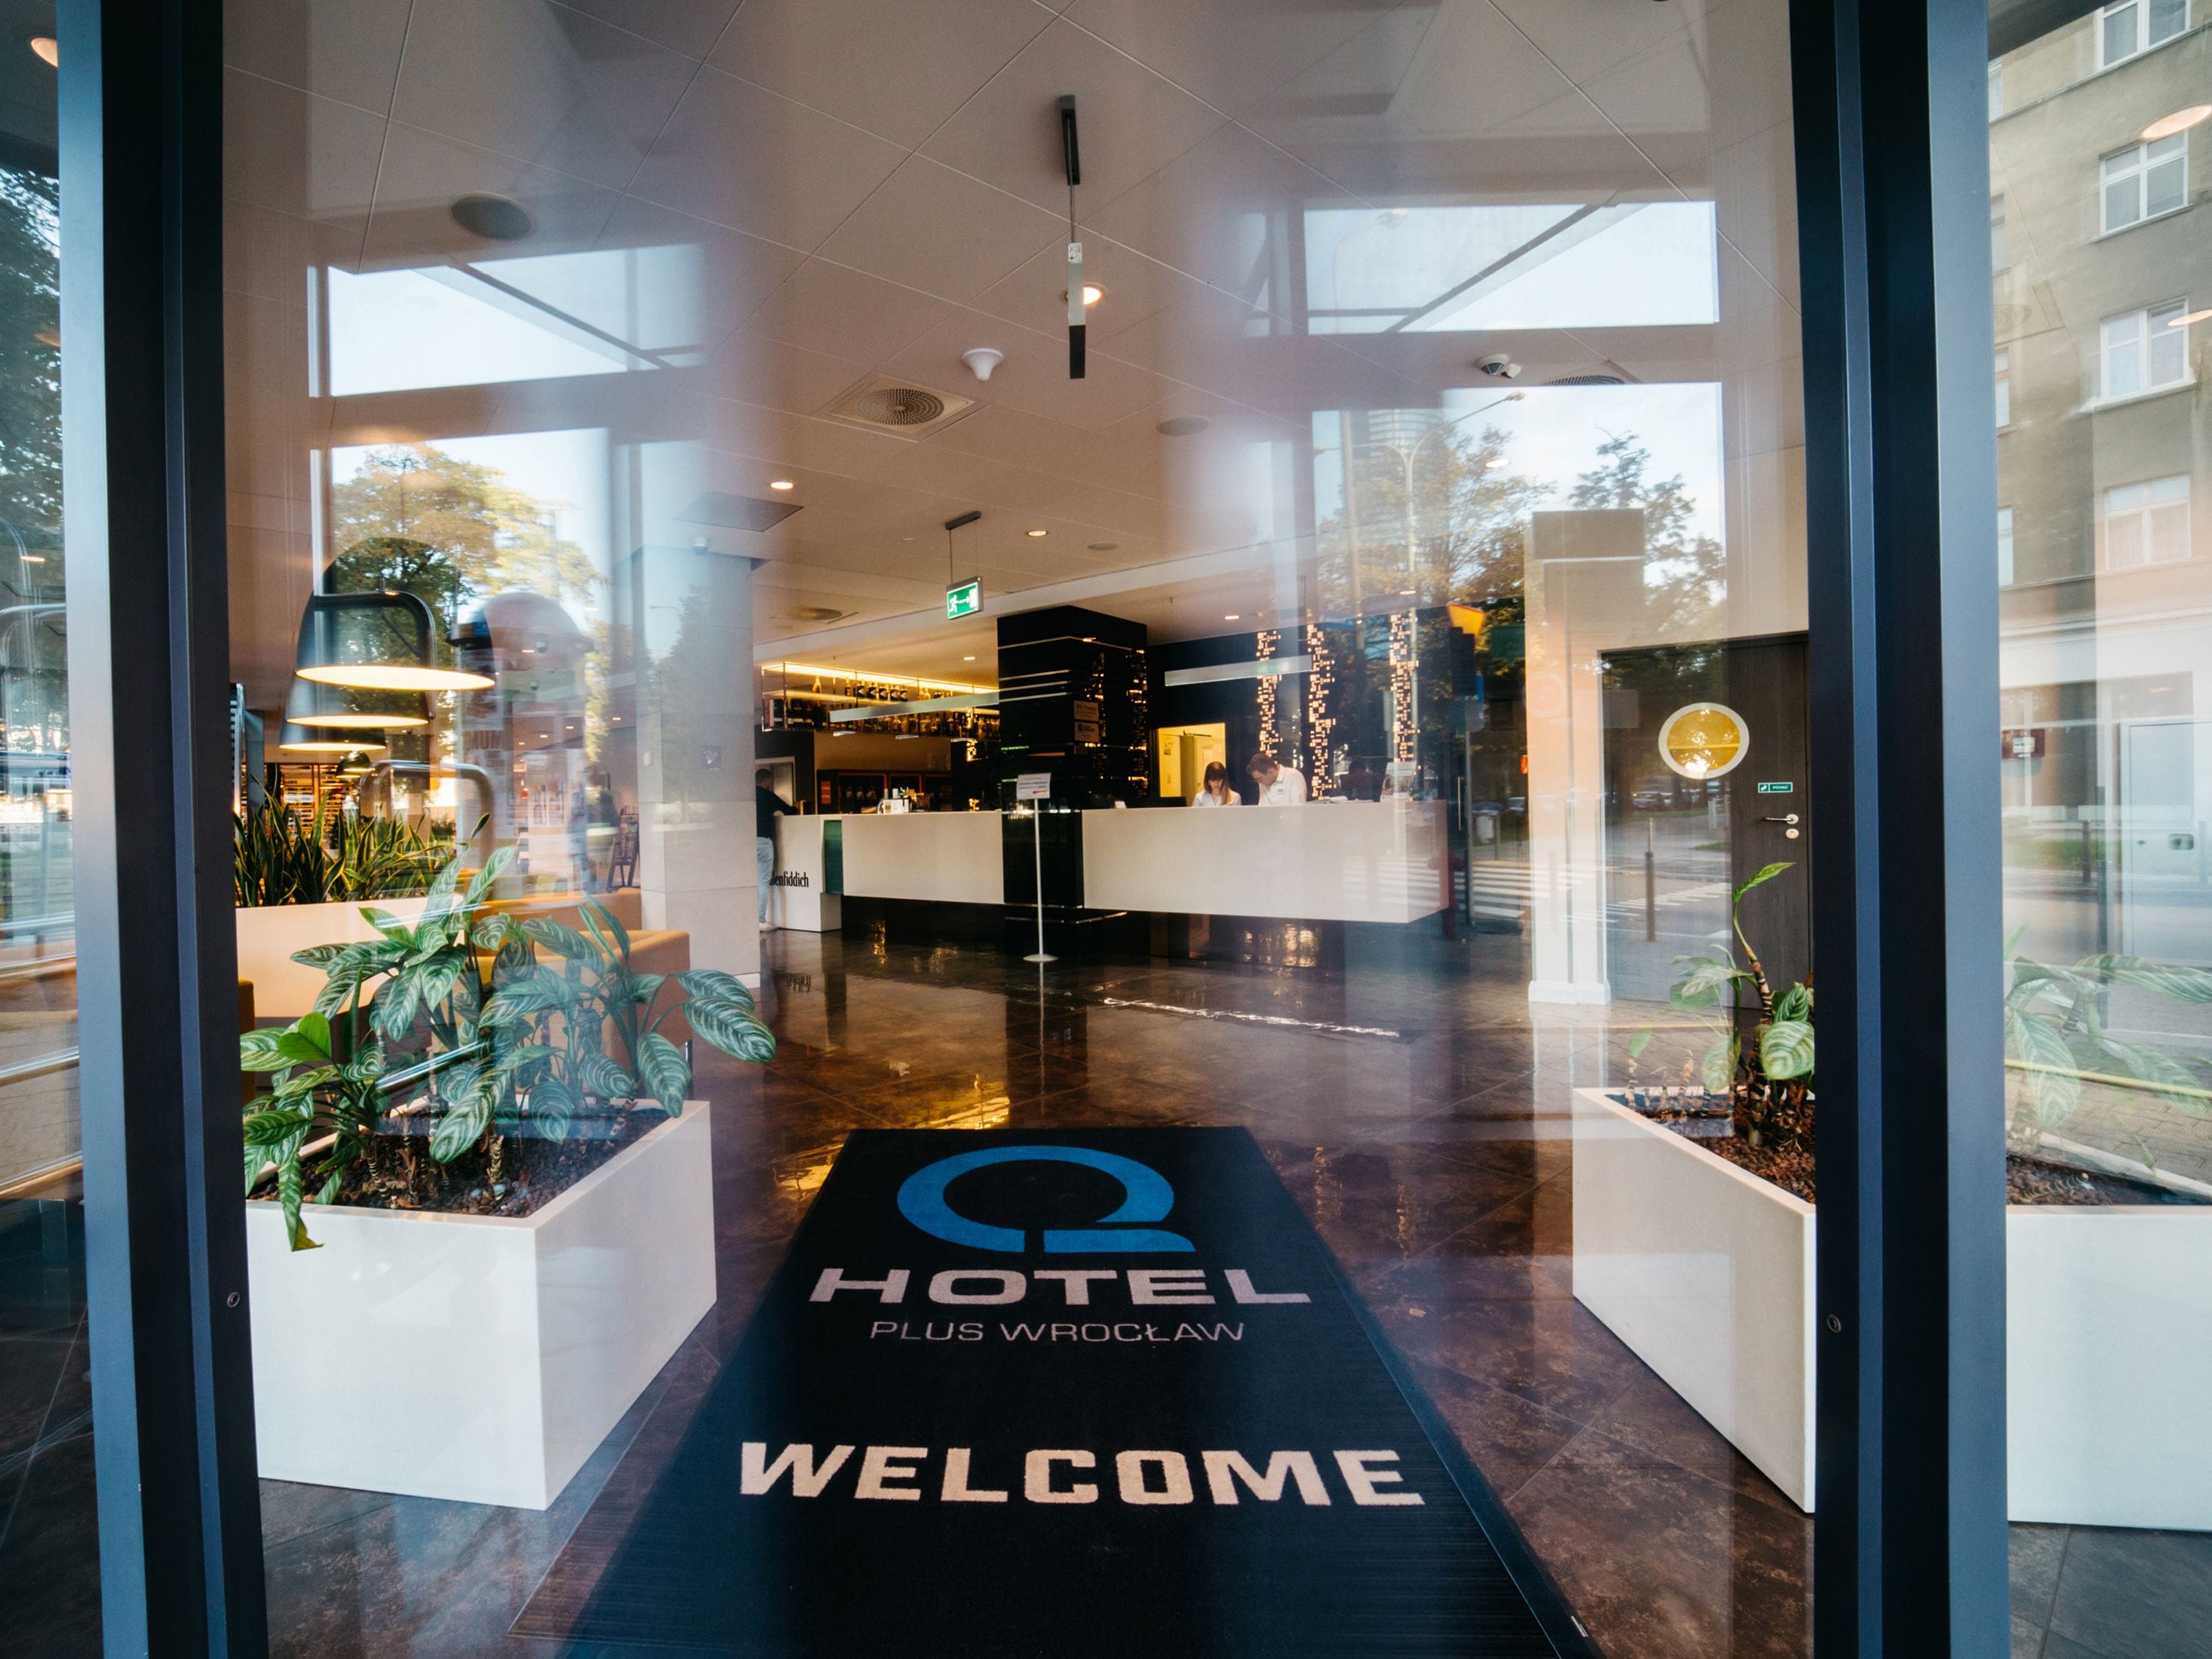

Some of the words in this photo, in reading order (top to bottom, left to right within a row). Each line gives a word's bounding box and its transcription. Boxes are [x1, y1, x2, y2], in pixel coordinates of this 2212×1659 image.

[810, 1268, 1311, 1304] HOTEL
[871, 1321, 984, 1340] PLUS
[1000, 1322, 1244, 1342] WROCŁAW
[740, 1441, 1426, 1506] WELCOME
